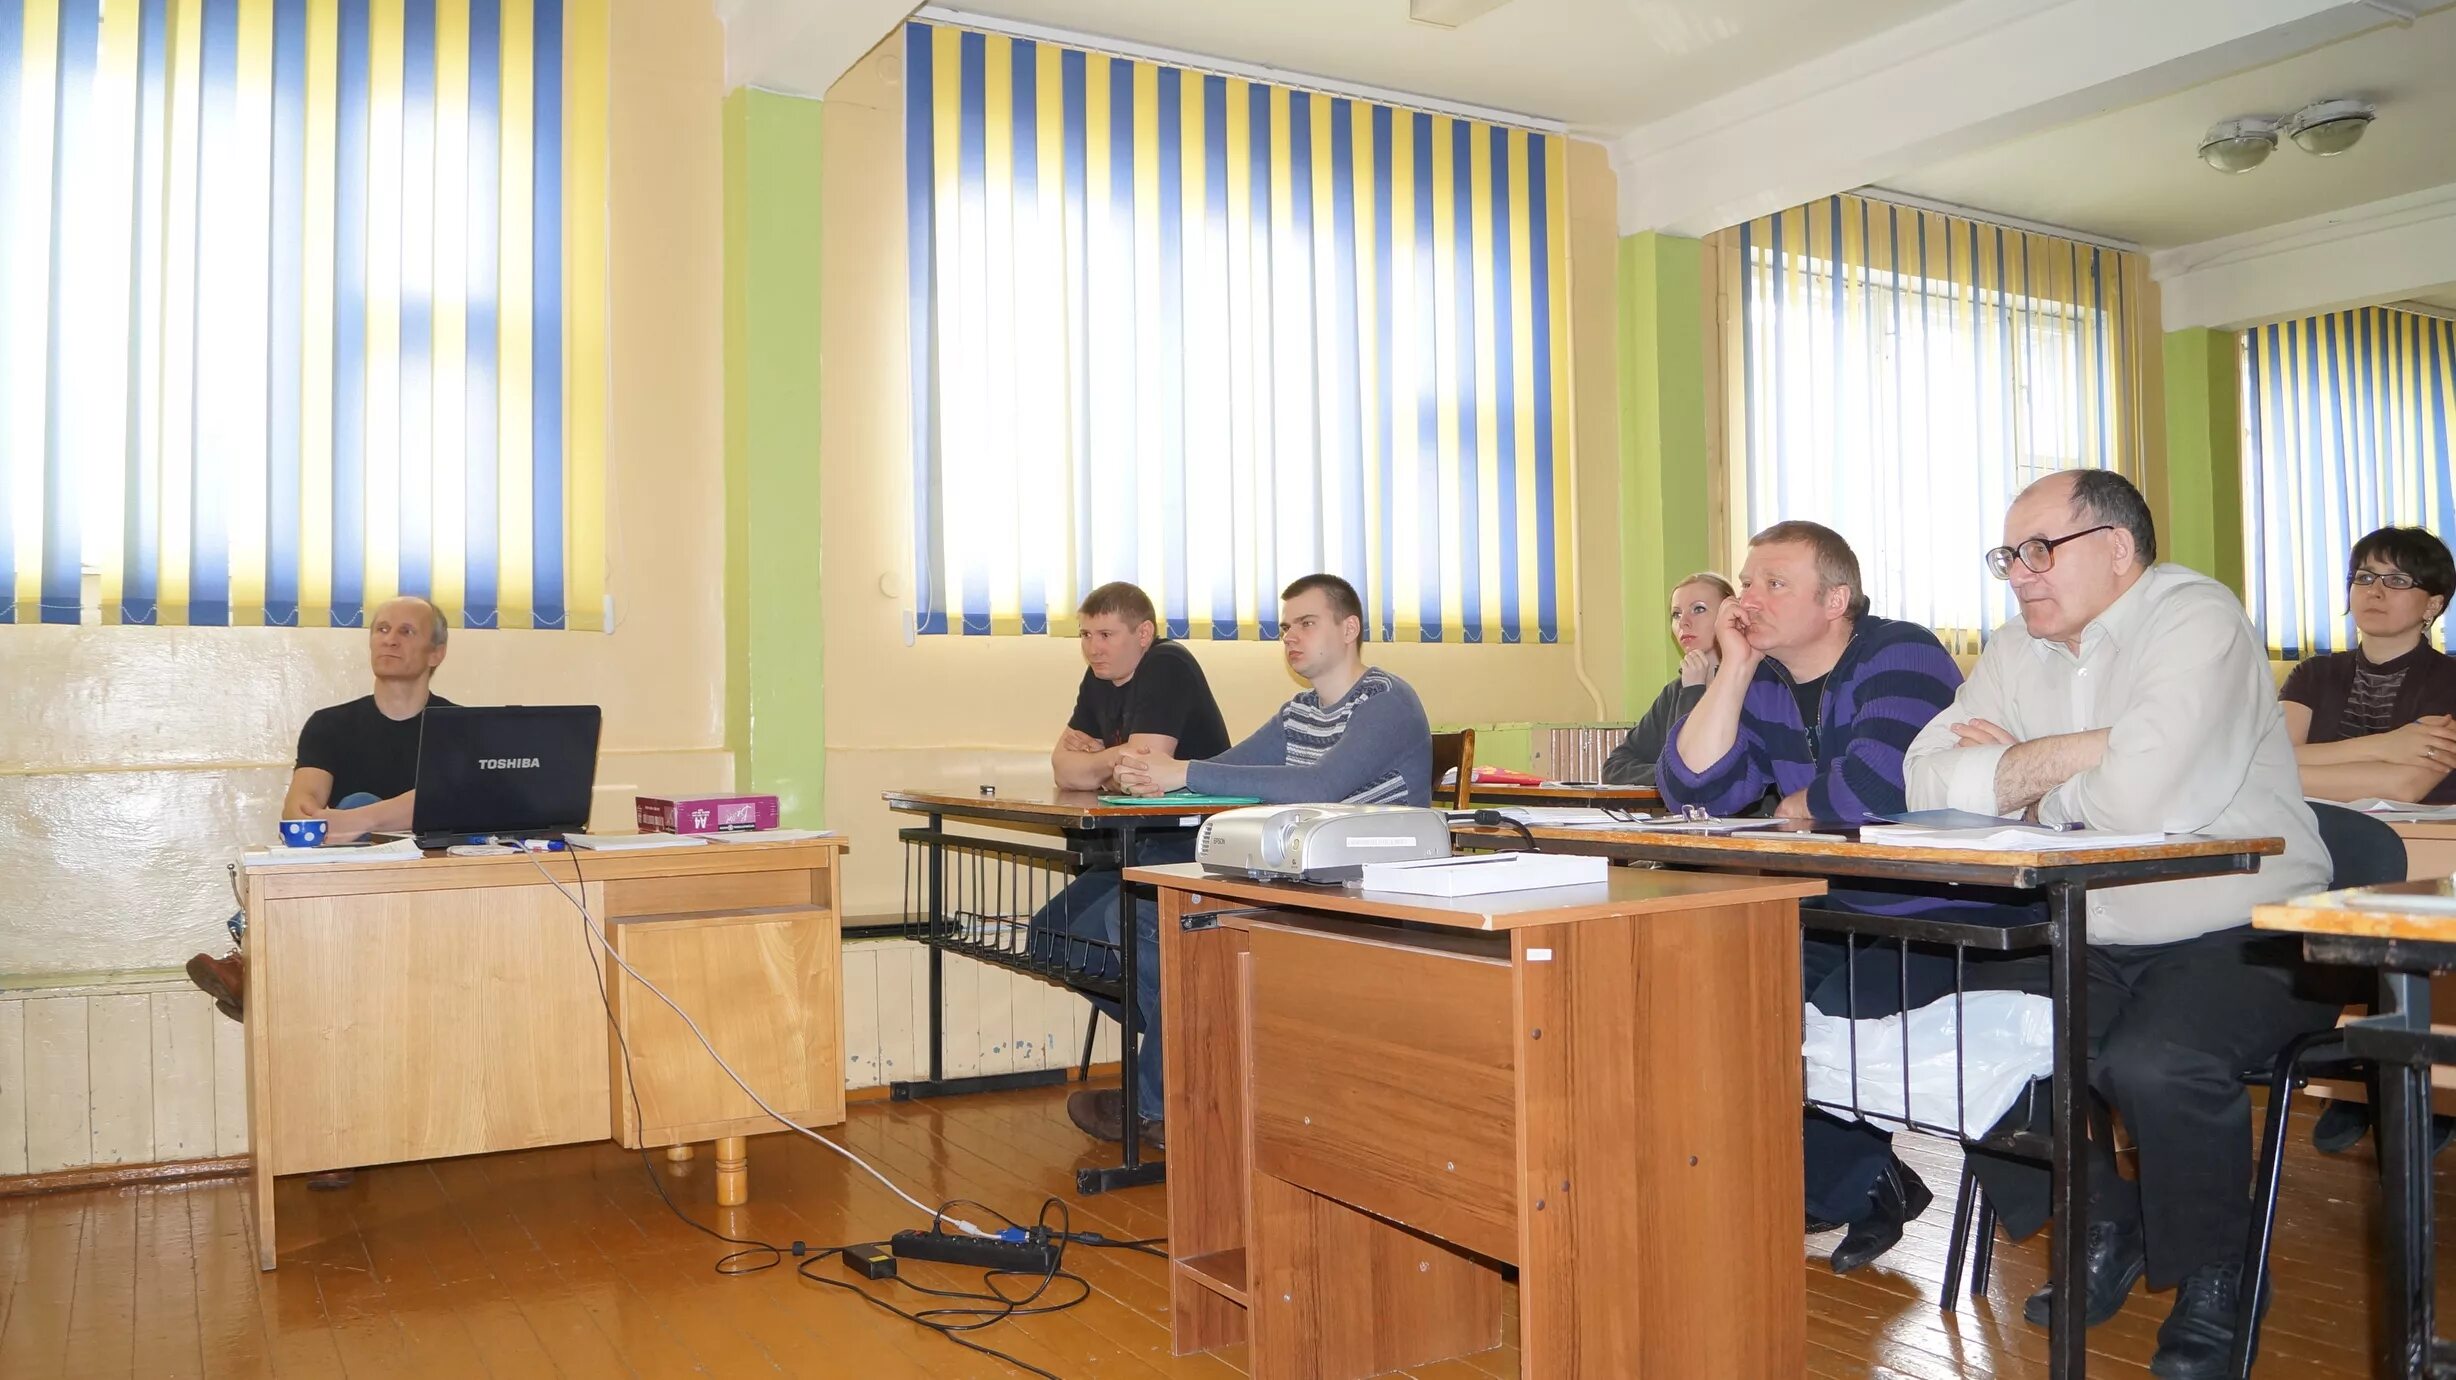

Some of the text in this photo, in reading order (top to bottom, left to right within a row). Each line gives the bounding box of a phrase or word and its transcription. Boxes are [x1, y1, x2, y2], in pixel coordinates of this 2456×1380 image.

[478, 758, 540, 770] TOSHIBA
[694, 816, 707, 829] A4
[1213, 837, 1226, 845] EPSON
